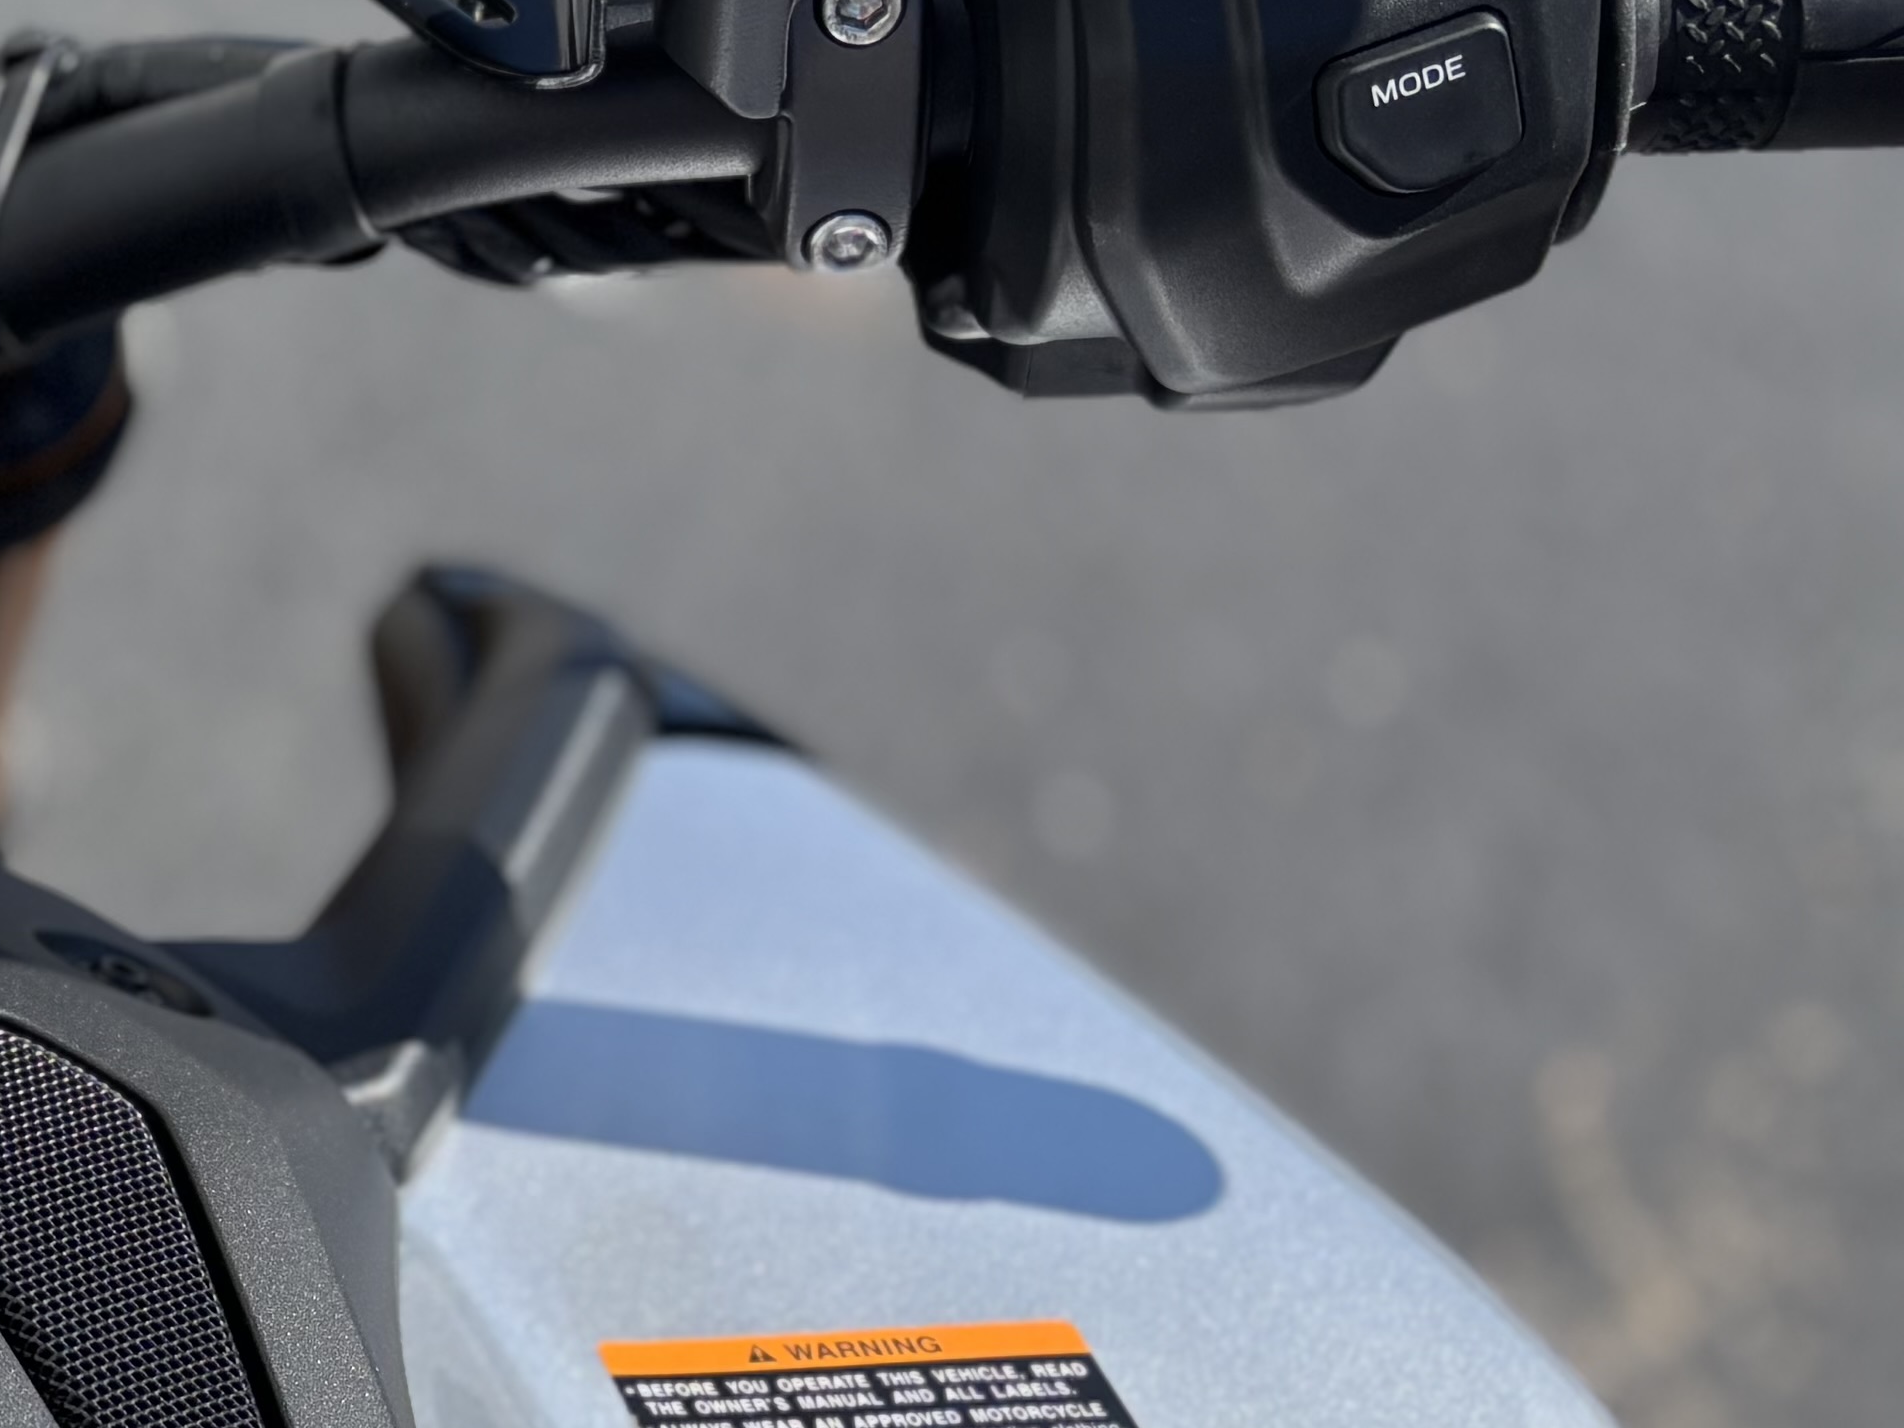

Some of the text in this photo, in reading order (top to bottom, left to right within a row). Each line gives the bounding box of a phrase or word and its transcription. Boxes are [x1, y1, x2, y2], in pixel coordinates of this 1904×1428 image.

[1371, 54, 1467, 108] MODE
[783, 1335, 942, 1361] WARNING
[638, 1380, 718, 1398] BEFORE
[725, 1379, 769, 1395] YOU
[777, 1373, 870, 1393] OPERATE
[877, 1370, 925, 1387] THIS
[1031, 1361, 1088, 1379] READ
[645, 1379, 1077, 1416] THE OWNER'S MANUAL AND ALL LABELS.
[968, 1402, 1108, 1424] MOTORCYCLE
